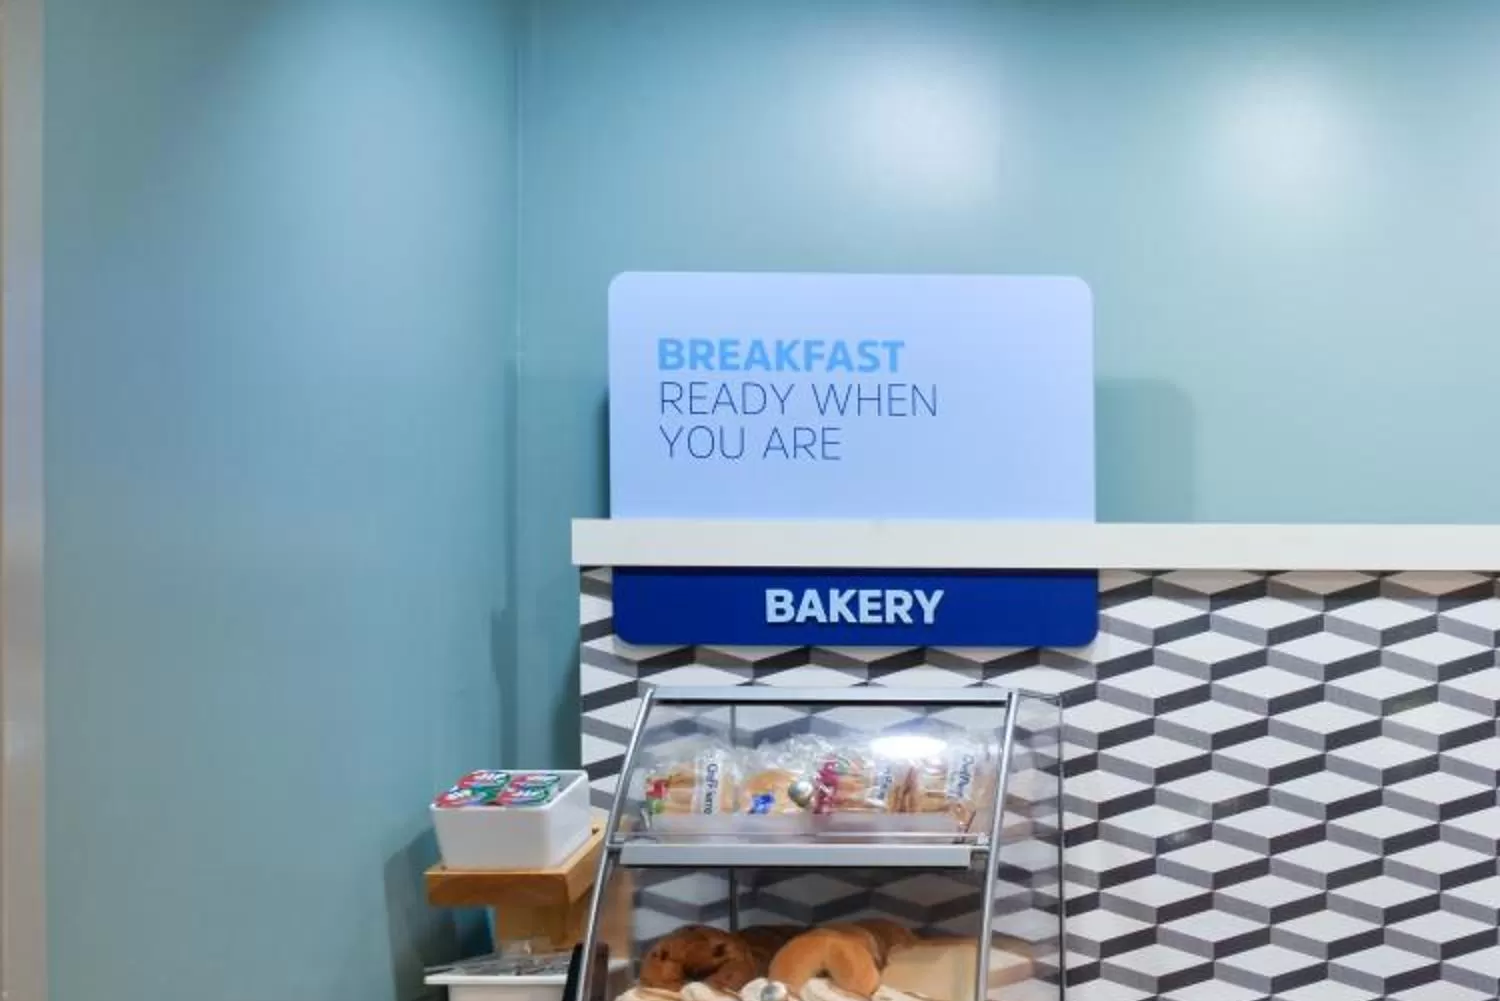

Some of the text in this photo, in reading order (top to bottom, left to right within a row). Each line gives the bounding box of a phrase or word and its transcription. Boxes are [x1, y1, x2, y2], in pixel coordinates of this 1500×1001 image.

[656, 337, 906, 374] BREAKFAST
[659, 381, 938, 418] READY WHEN
[659, 424, 842, 461] YOU ARE
[764, 587, 946, 625] BAKERY
